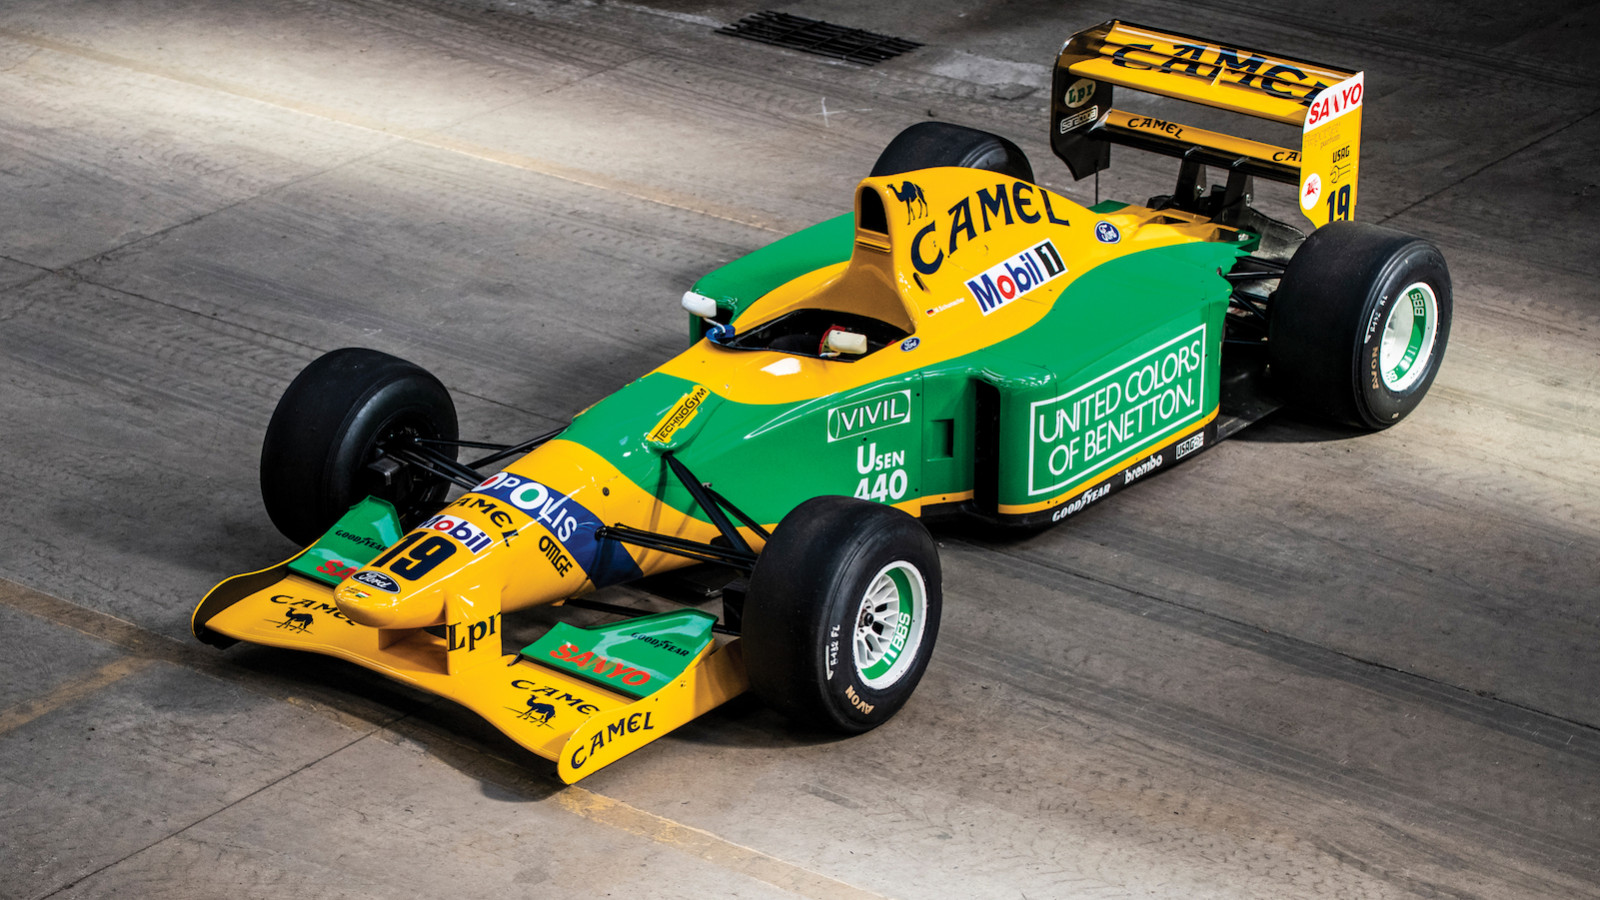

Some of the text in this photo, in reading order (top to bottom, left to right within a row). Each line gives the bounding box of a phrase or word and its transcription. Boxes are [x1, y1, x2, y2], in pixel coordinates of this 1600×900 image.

[1127, 118, 1184, 139] CAMEL
[1272, 150, 1302, 162] CA
[1332, 145, 1351, 163] USAG
[1327, 184, 1351, 222] 19
[911, 181, 1070, 275] CAMEL
[967, 245, 1061, 312] Mobil 1
[1370, 346, 1379, 390] AVON
[1038, 339, 1201, 443] UNITED COLORS
[840, 398, 906, 431] VIVIL
[1048, 437, 1080, 476] OF
[1176, 440, 1195, 459] USAG
[853, 471, 908, 502] 440
[1124, 454, 1163, 485] brembo
[1052, 483, 1111, 522] GOODYEAR
[418, 515, 493, 554] Mobil
[371, 531, 457, 580] 19
[358, 571, 392, 588] Ford
[446, 612, 501, 653] Lpr
[631, 631, 690, 657] GOODYEAR
[511, 679, 601, 716] CAME
[845, 684, 875, 715] AVON
[571, 712, 655, 769] CAMEL
